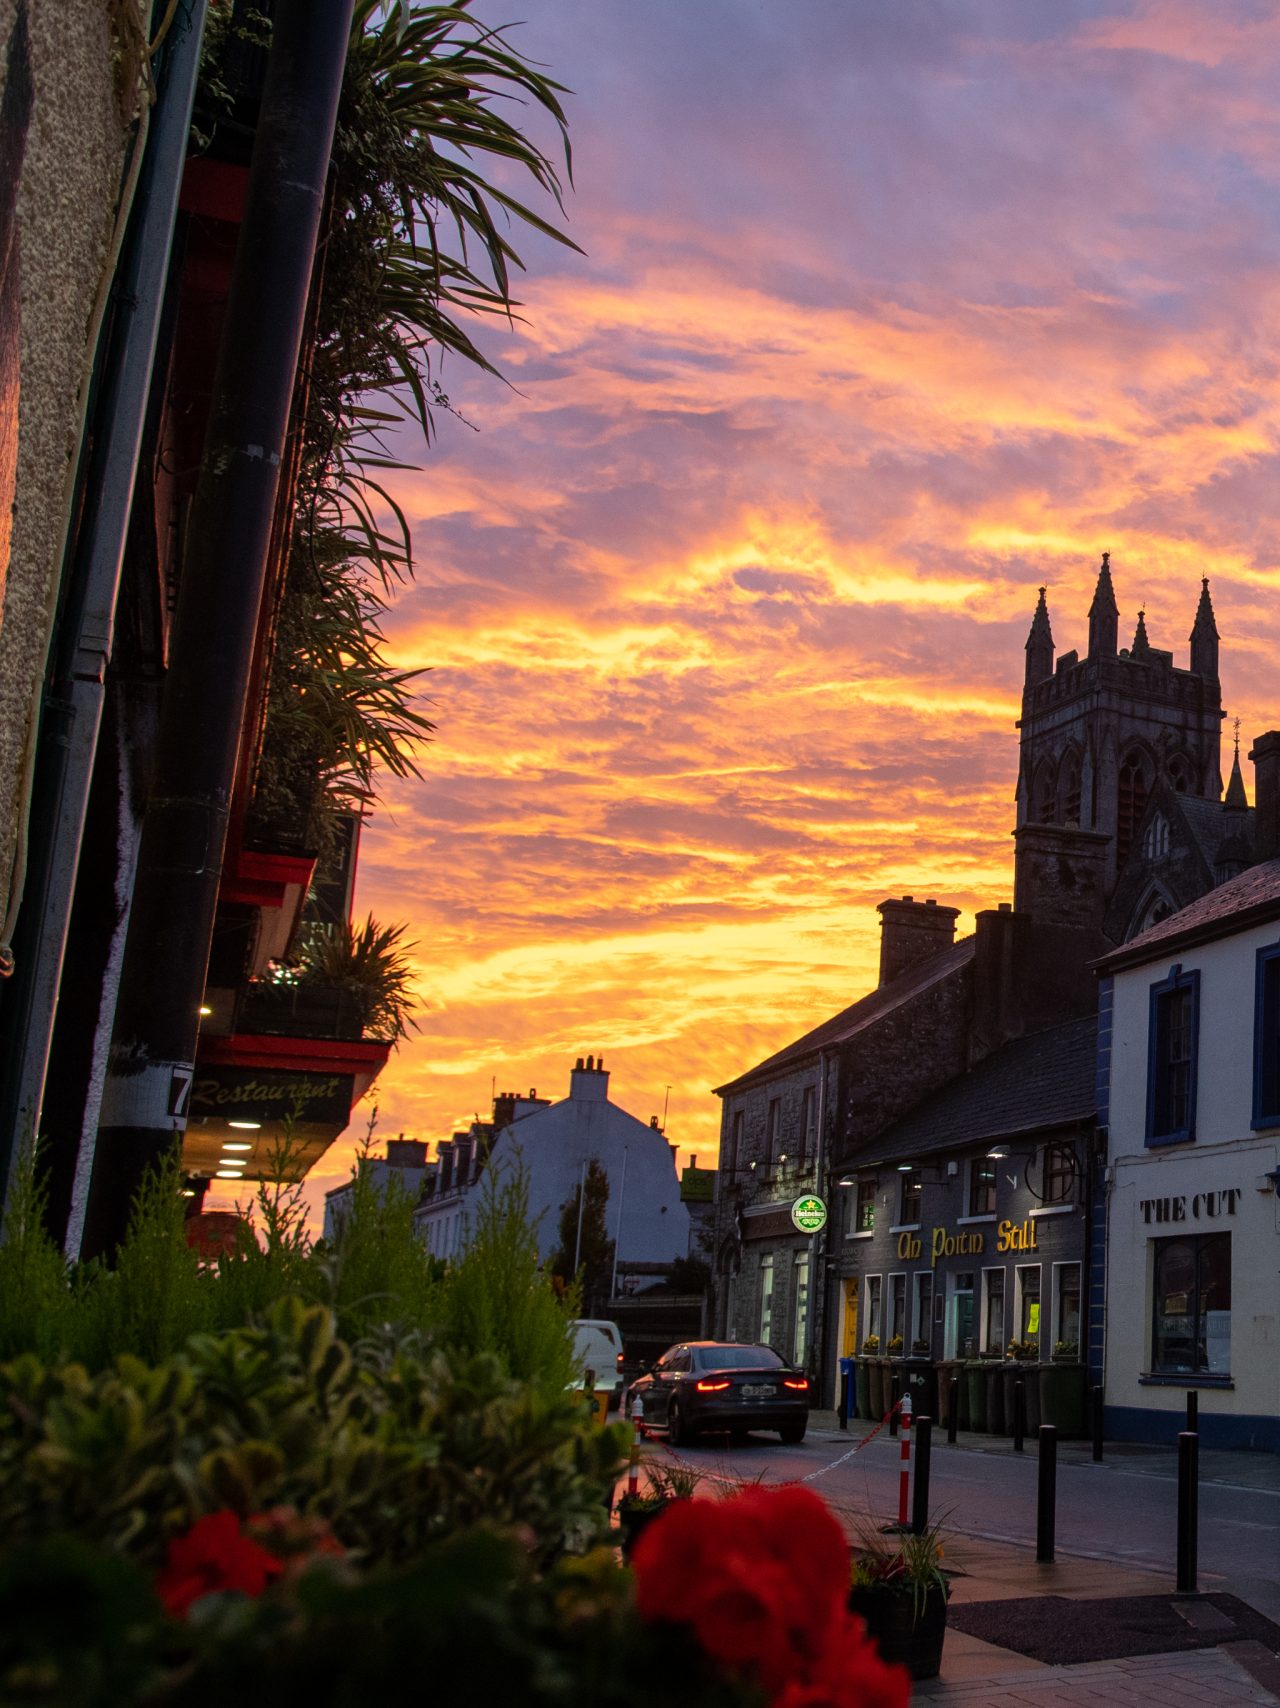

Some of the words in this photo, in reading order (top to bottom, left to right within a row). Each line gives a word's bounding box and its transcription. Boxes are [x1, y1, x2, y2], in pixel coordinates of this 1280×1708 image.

[193, 1077, 341, 1106] Restaurant
[794, 1209, 826, 1218] Heineken
[1140, 1196, 1187, 1224] THE
[1192, 1188, 1241, 1219] CUT
[897, 1232, 922, 1260] An
[996, 1218, 1038, 1253] Still
